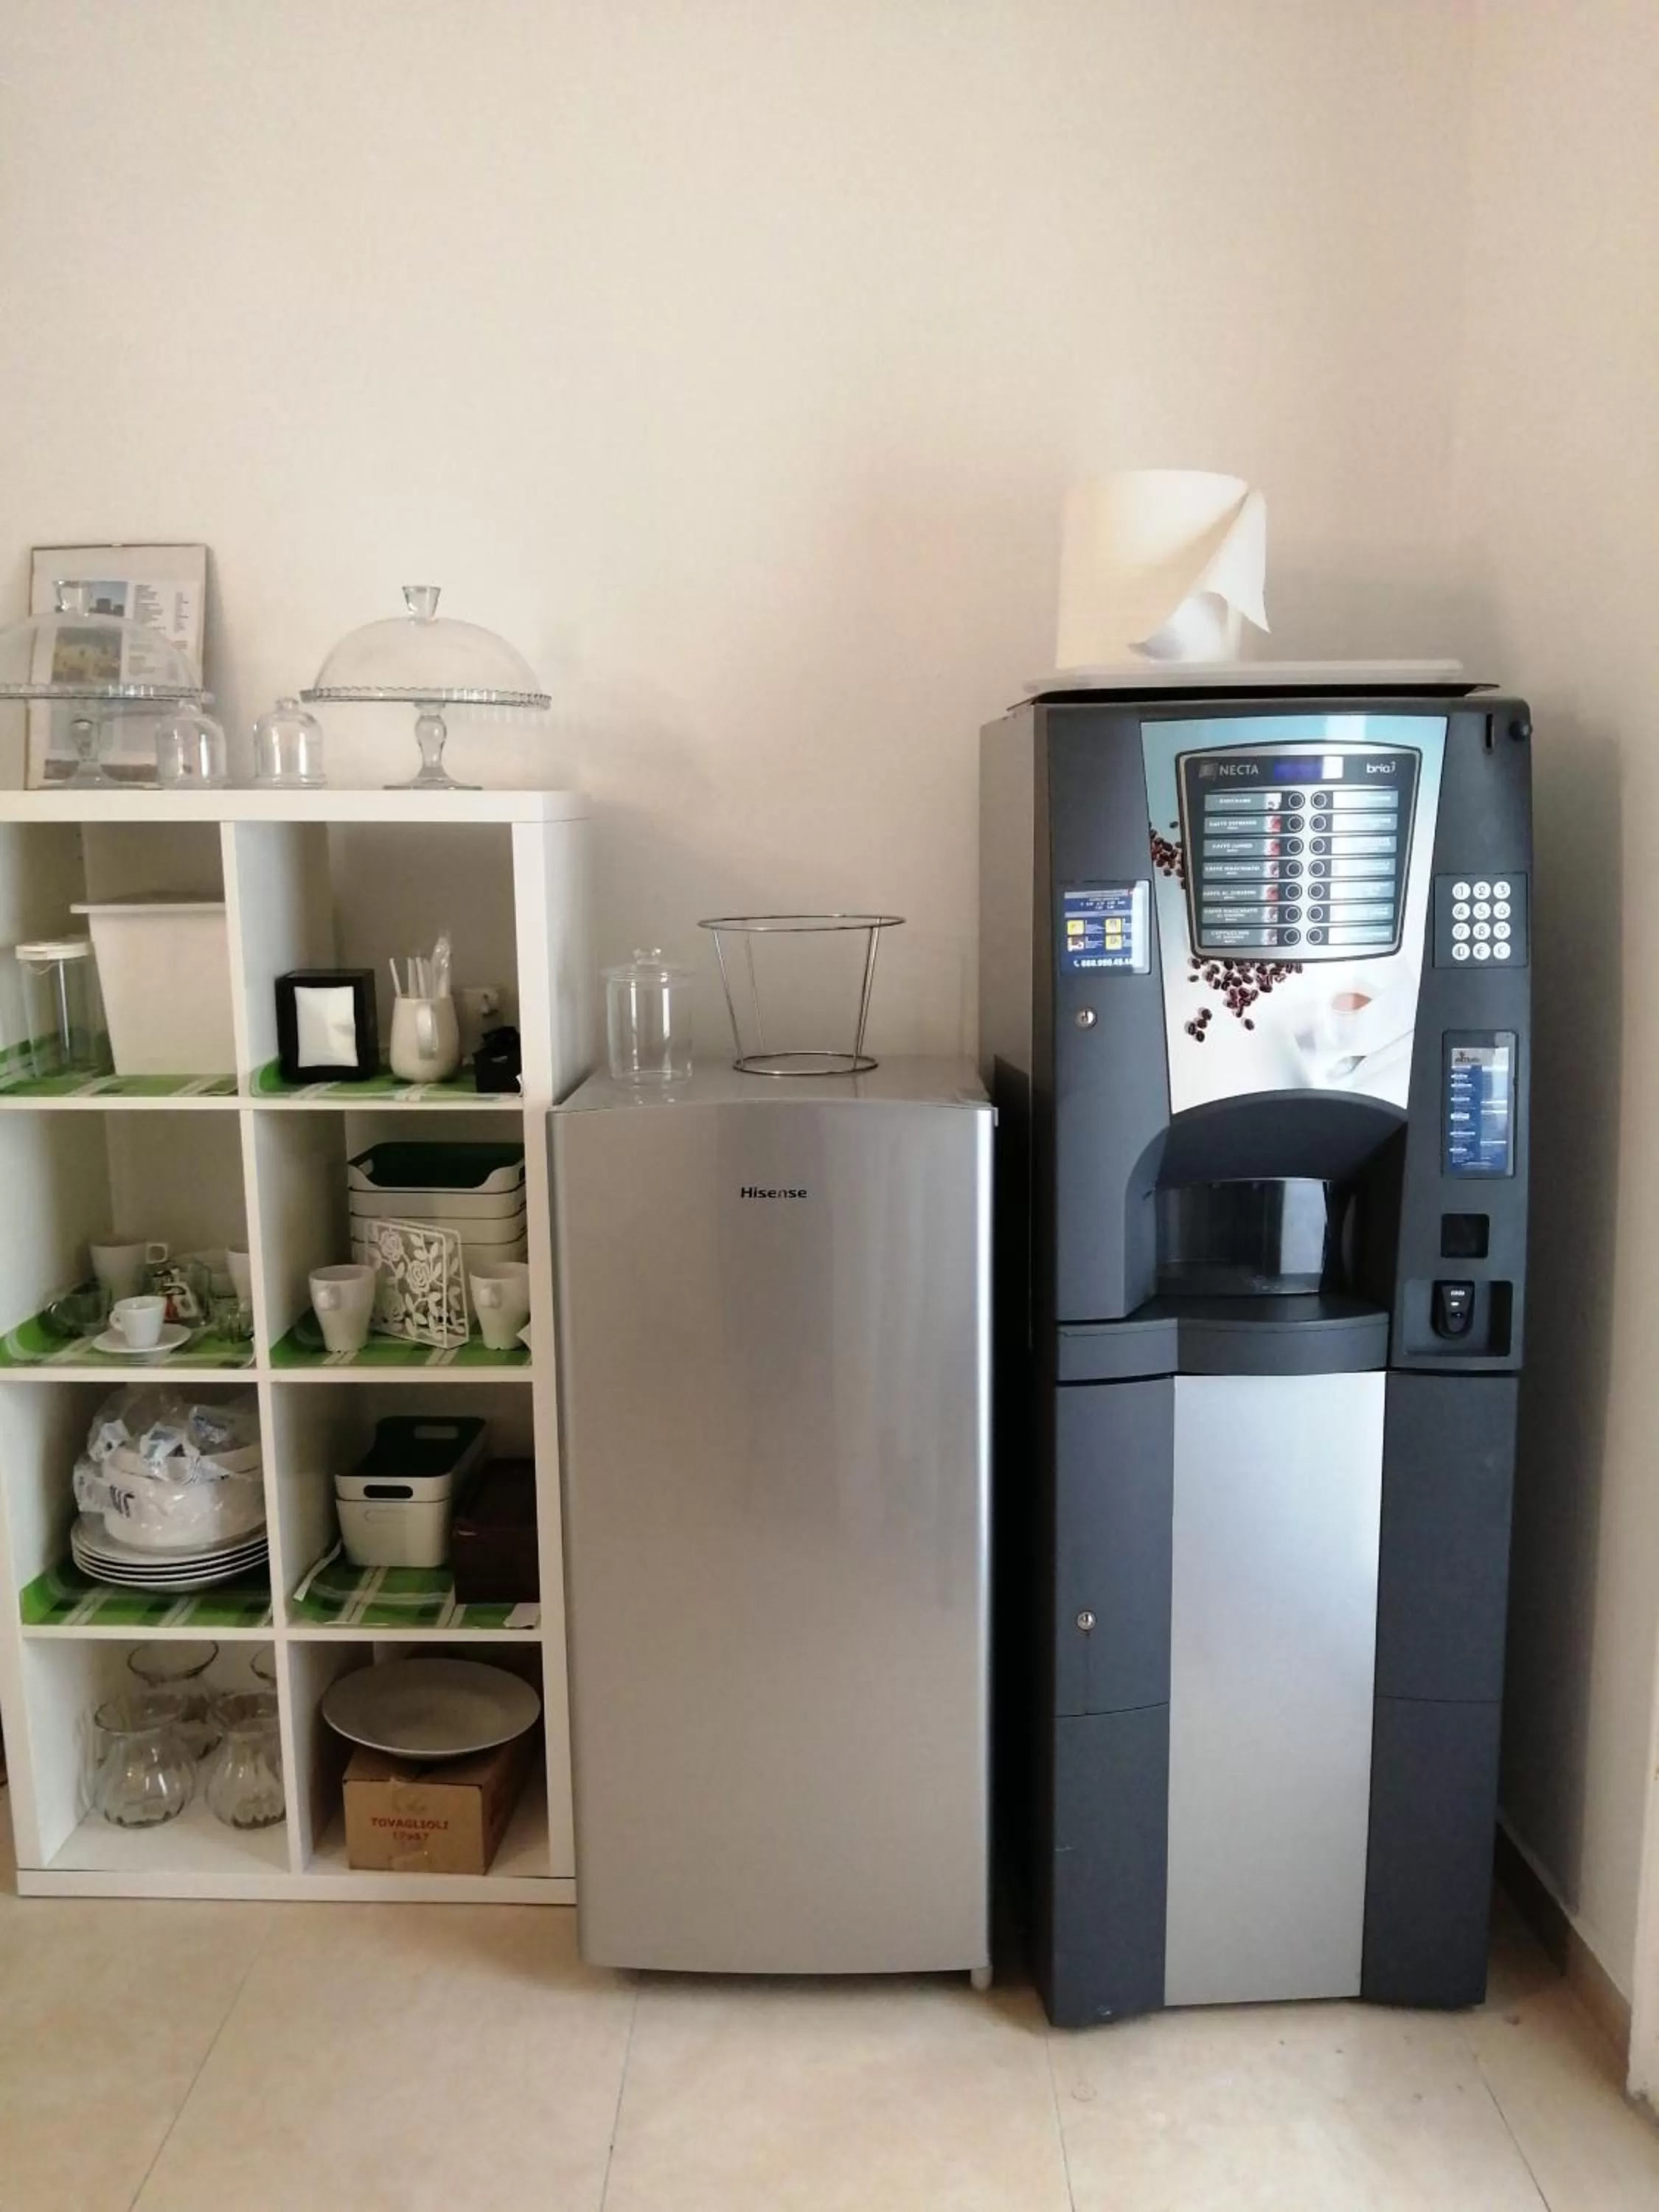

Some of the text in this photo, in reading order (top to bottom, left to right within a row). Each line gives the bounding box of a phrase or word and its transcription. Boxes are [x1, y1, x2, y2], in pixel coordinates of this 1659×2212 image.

[1219, 764, 1259, 776] NECTA
[740, 1186, 807, 1198] Hisense
[371, 1817, 449, 1830] TOVAGLIOLI
